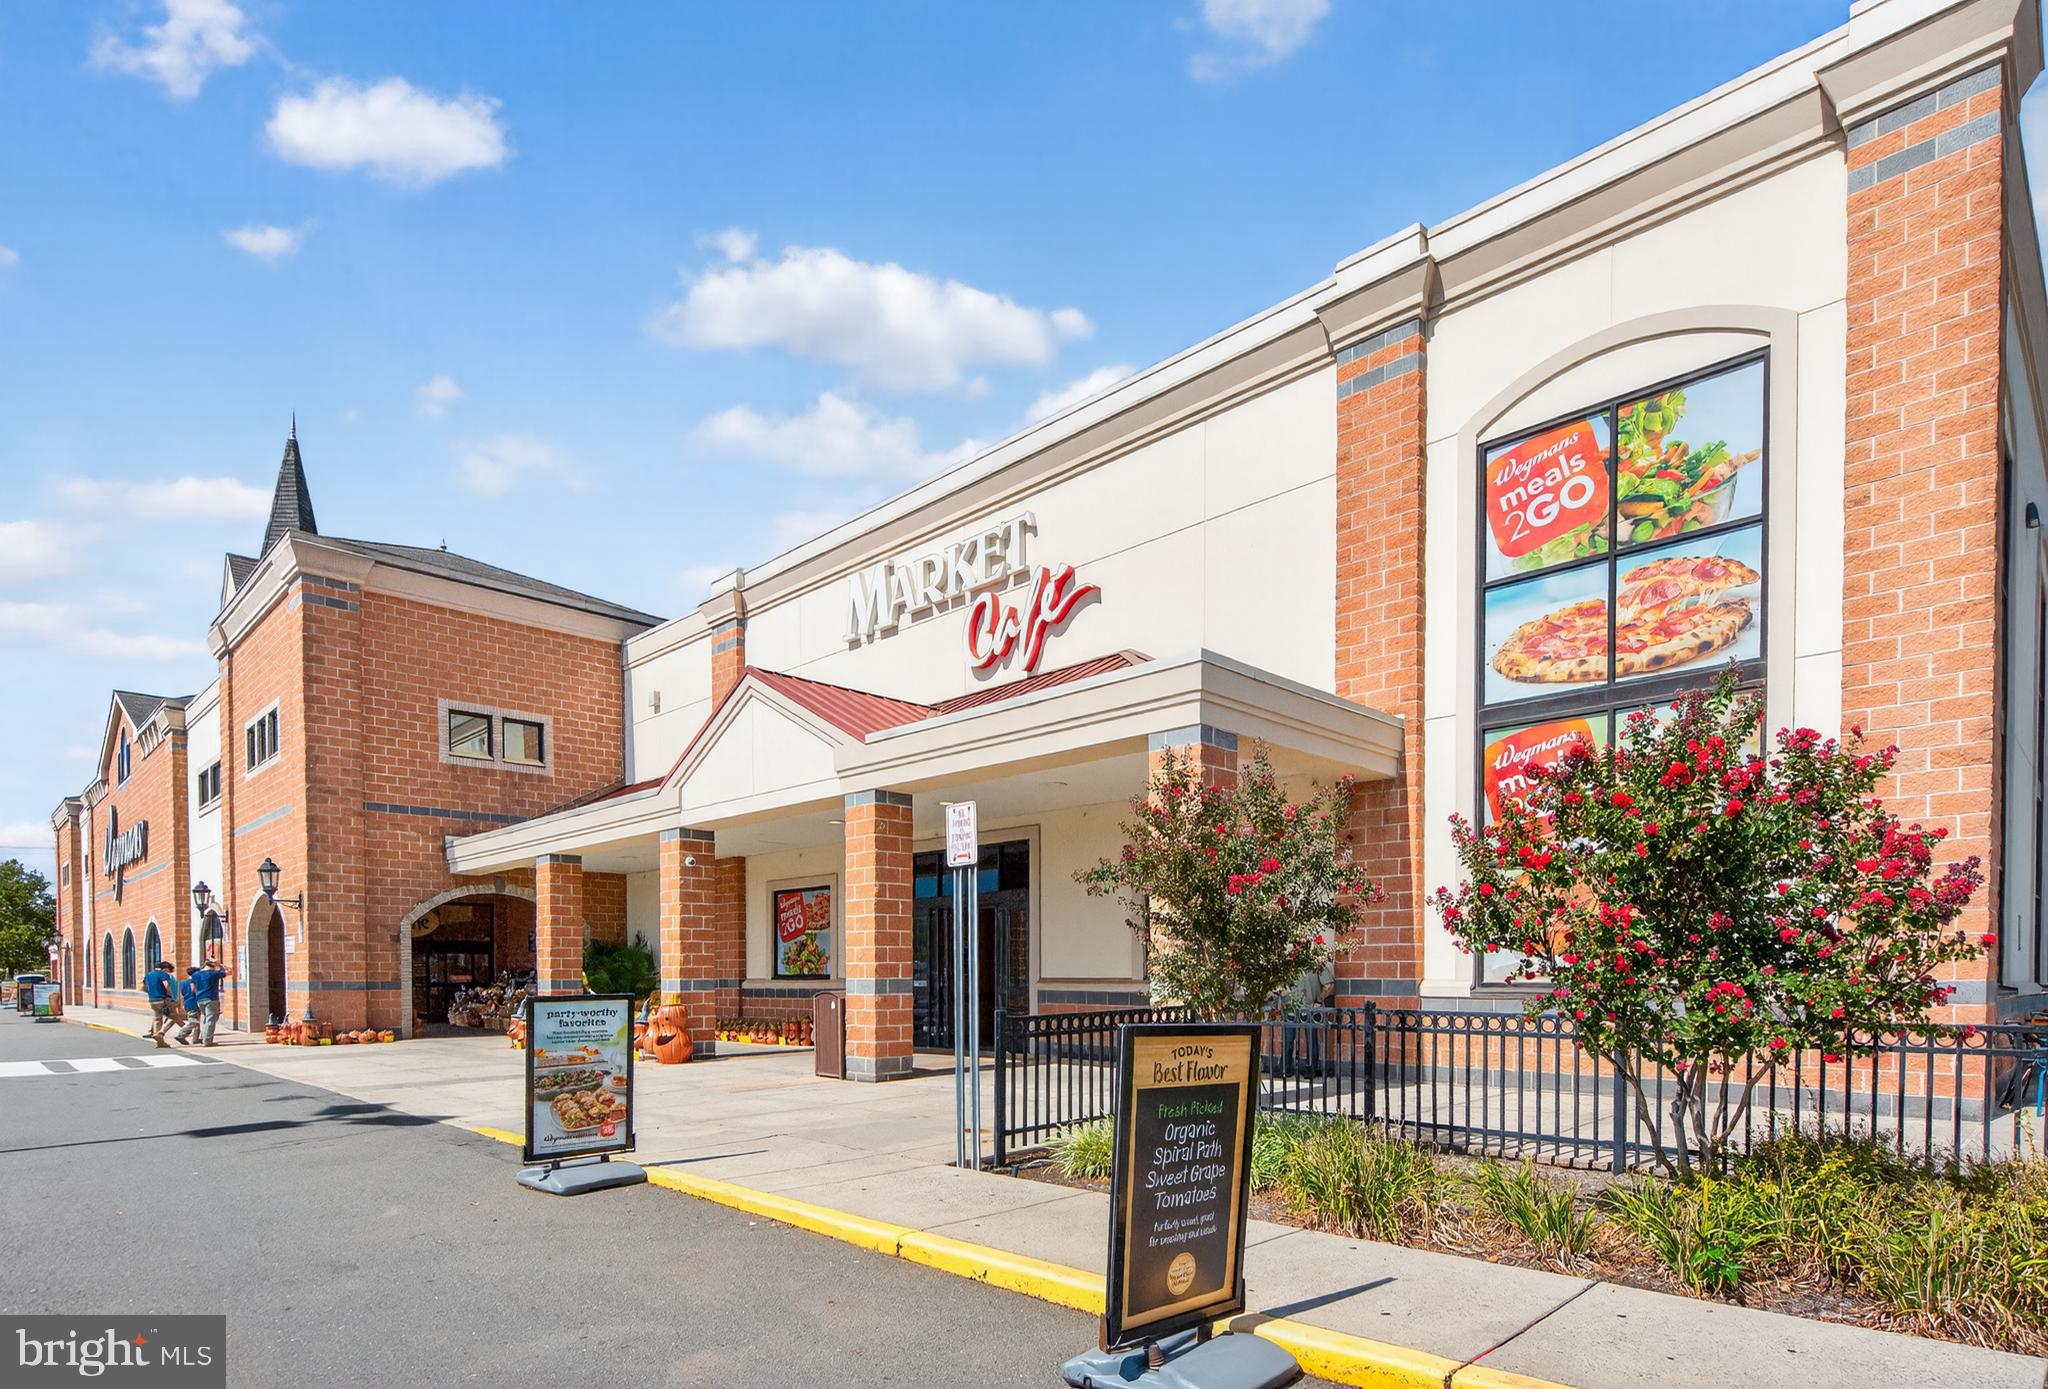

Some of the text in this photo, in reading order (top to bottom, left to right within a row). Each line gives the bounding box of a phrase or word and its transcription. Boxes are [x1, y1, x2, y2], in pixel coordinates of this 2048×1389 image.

[1493, 431, 1579, 487] Wegmans
[1499, 452, 1586, 513] meals
[1504, 474, 1595, 543] 2GO
[842, 510, 1038, 643] MARKET
[1492, 729, 1578, 770] Wegmans
[559, 1018, 607, 1028] favorites
[1171, 1045, 1214, 1060] TODAY'S
[1153, 1060, 1229, 1084] Best Flavor
[1164, 1120, 1216, 1145] Organic
[1153, 1139, 1222, 1170] Spiral Path
[1145, 1163, 1226, 1188] Sweet Grape
[1154, 1186, 1217, 1210] Tomatoes
